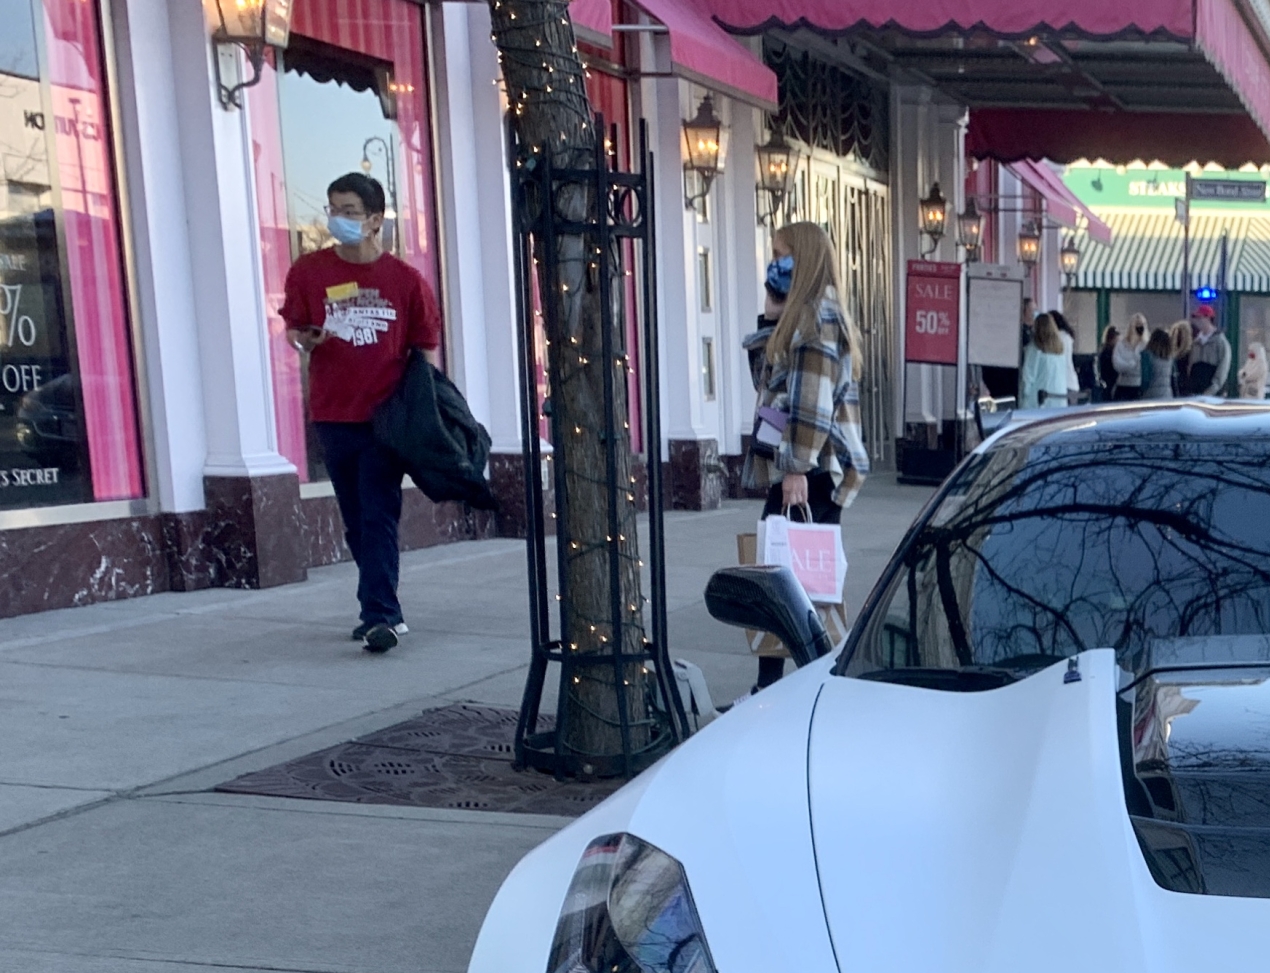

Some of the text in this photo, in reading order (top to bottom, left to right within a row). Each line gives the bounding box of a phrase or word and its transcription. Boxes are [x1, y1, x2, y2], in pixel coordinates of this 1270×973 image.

[915, 283, 953, 299] SALE
[915, 310, 950, 334] 50%
[2, 364, 41, 392] OFF
[12, 467, 59, 486] SECRET
